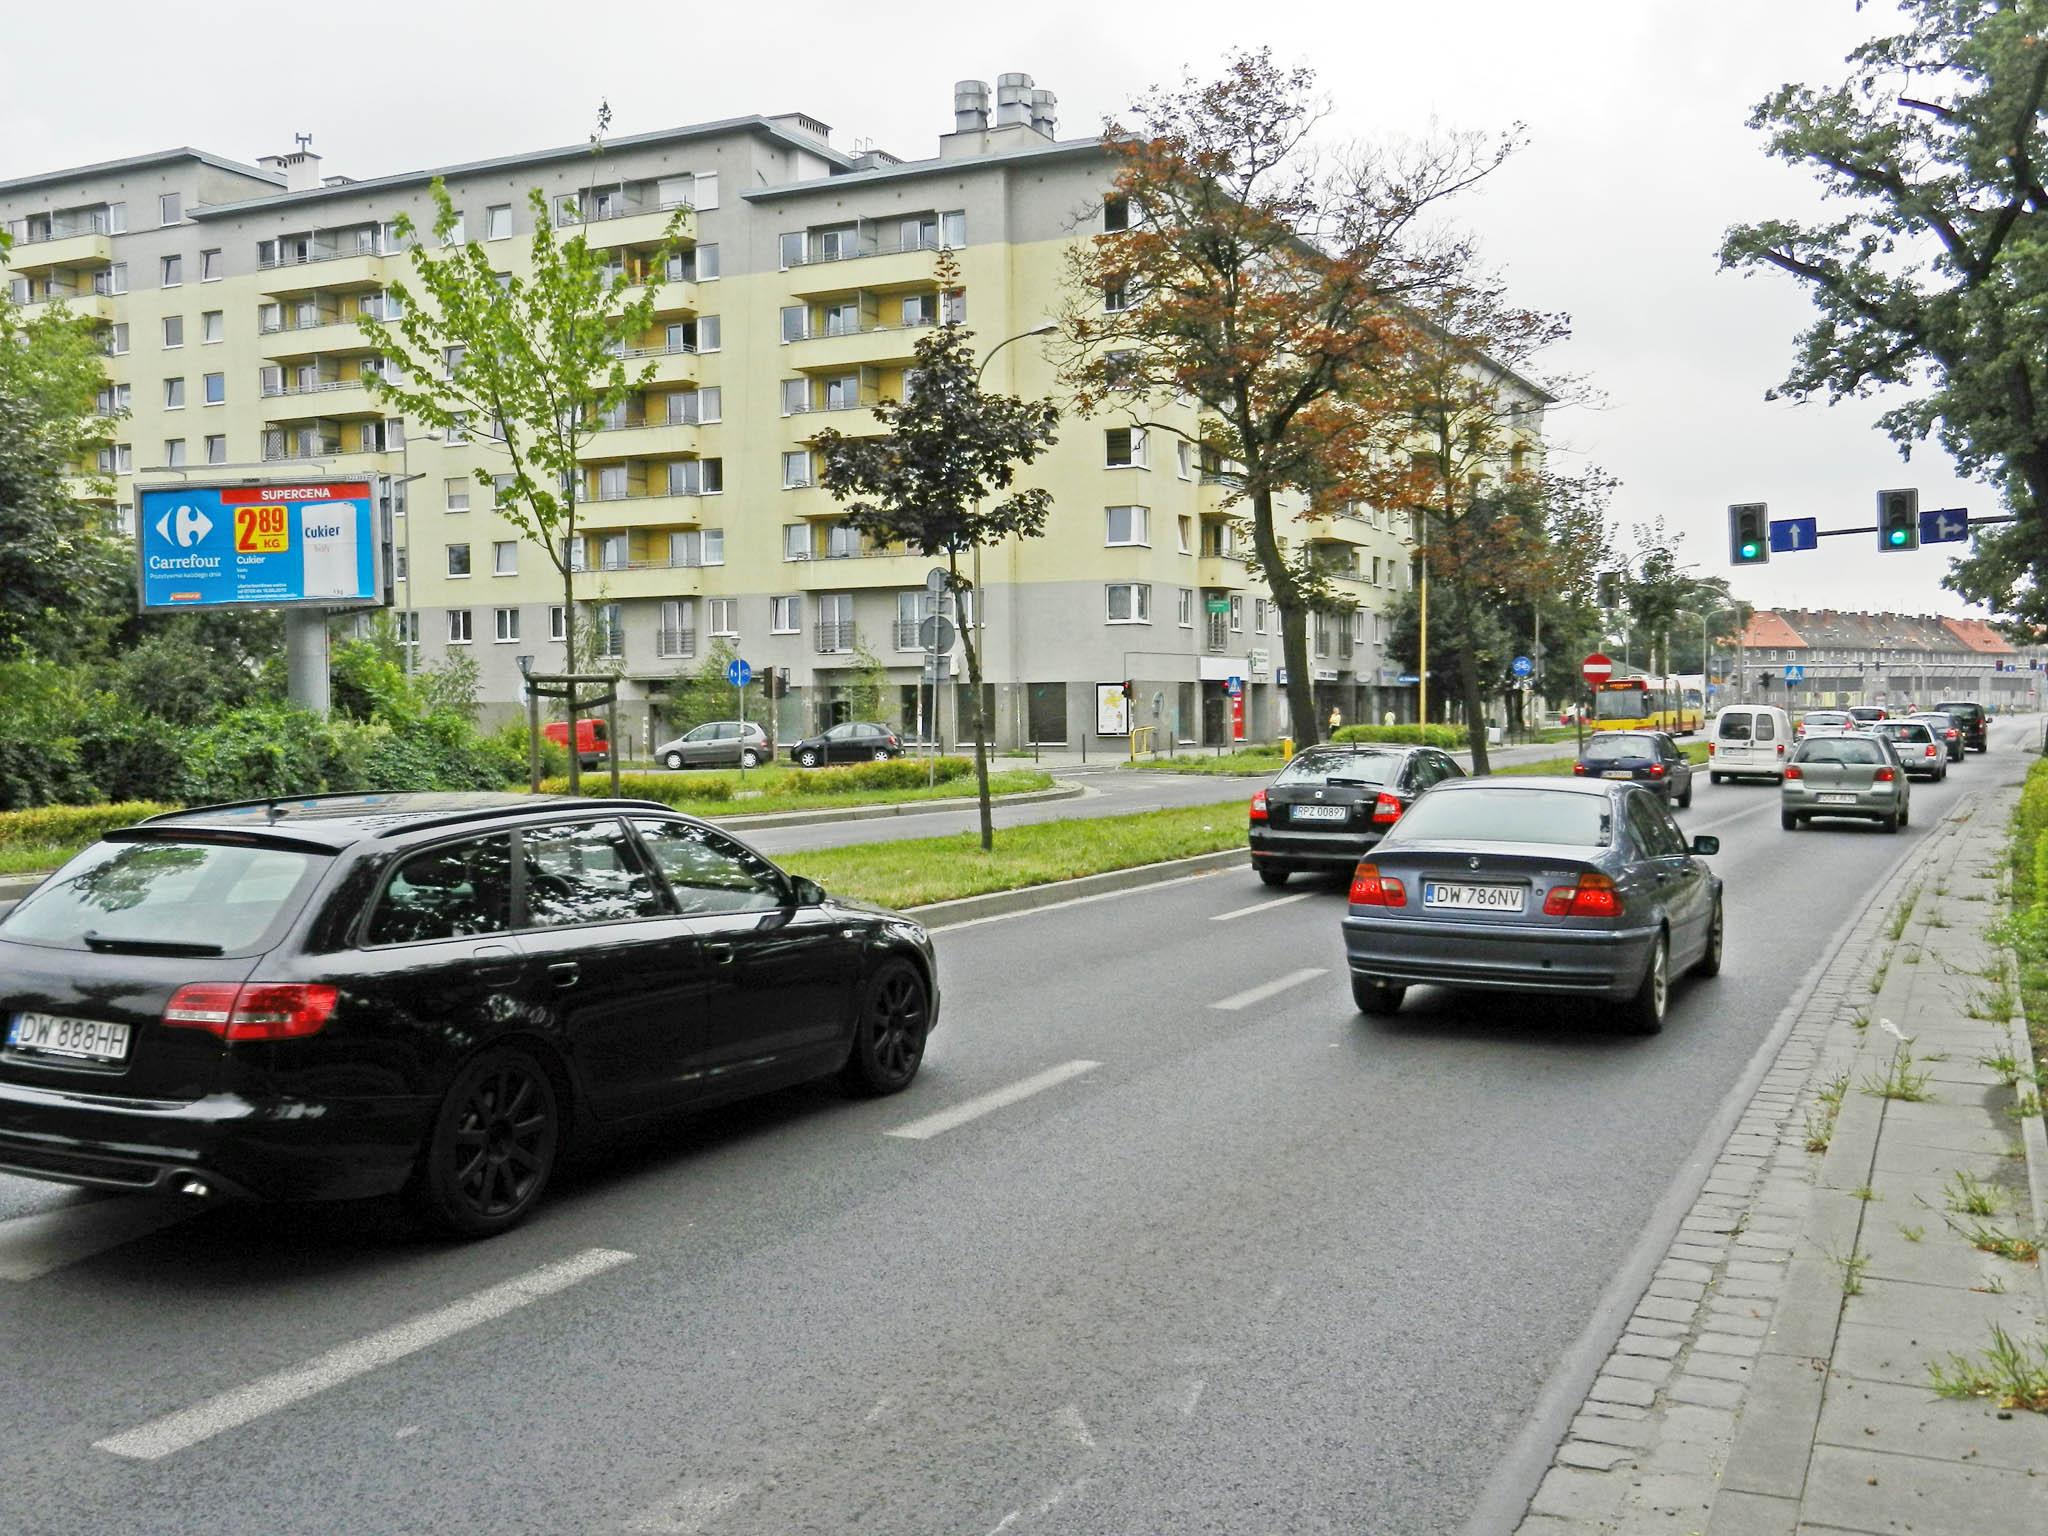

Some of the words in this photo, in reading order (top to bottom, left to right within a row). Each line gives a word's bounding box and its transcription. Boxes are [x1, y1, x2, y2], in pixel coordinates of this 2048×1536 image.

[261, 487, 331, 500] SUPERCENA
[305, 525, 341, 538] Cukier
[264, 539, 280, 548] KG
[149, 553, 221, 569] Carrefour
[236, 555, 266, 564] Cukier
[1317, 807, 1345, 817] 00897
[1437, 887, 1461, 903] DW
[1467, 888, 1519, 906] 786NV
[21, 1014, 55, 1044] DW
[58, 1019, 127, 1055] 888HH
